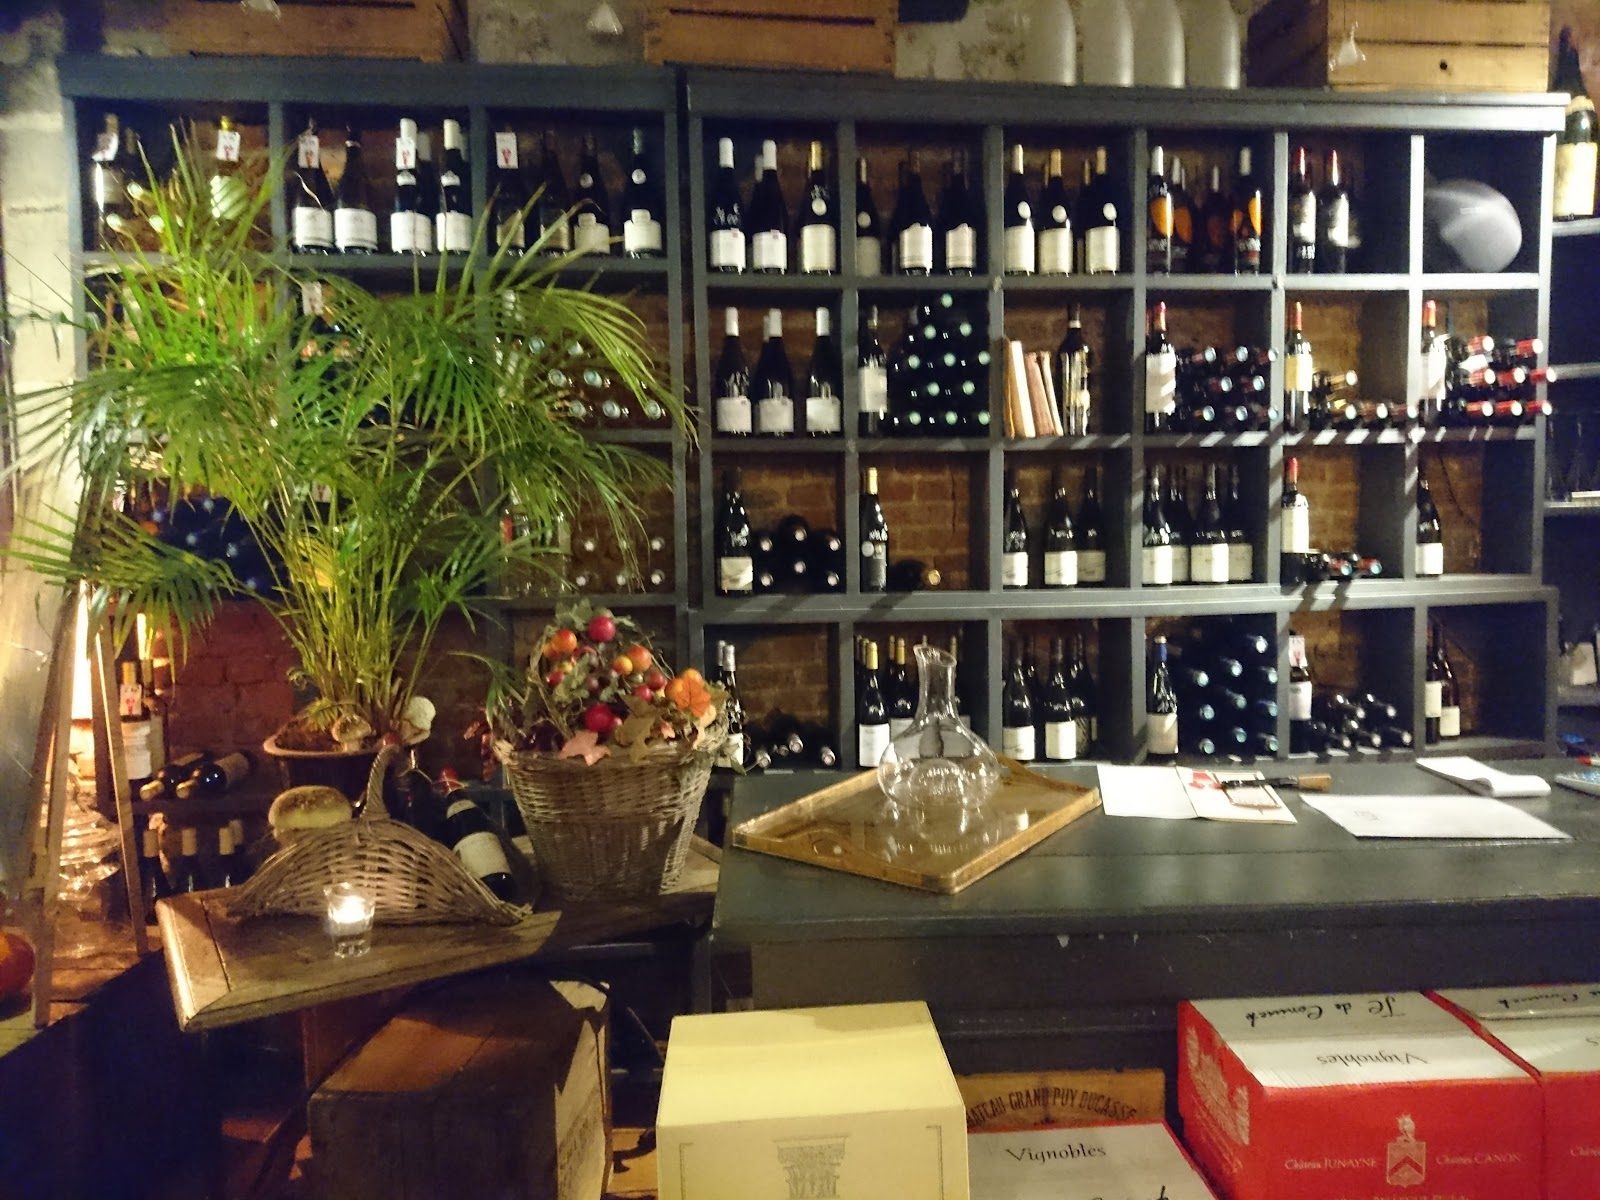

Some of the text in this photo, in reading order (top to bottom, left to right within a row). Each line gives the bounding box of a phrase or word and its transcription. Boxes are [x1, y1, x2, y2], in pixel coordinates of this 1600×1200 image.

[1334, 1002, 1352, 1015] de
[1317, 1051, 1429, 1067] Vignobles
[1053, 1086, 1078, 1108] PUY
[1006, 1143, 1107, 1163] Vignobles
